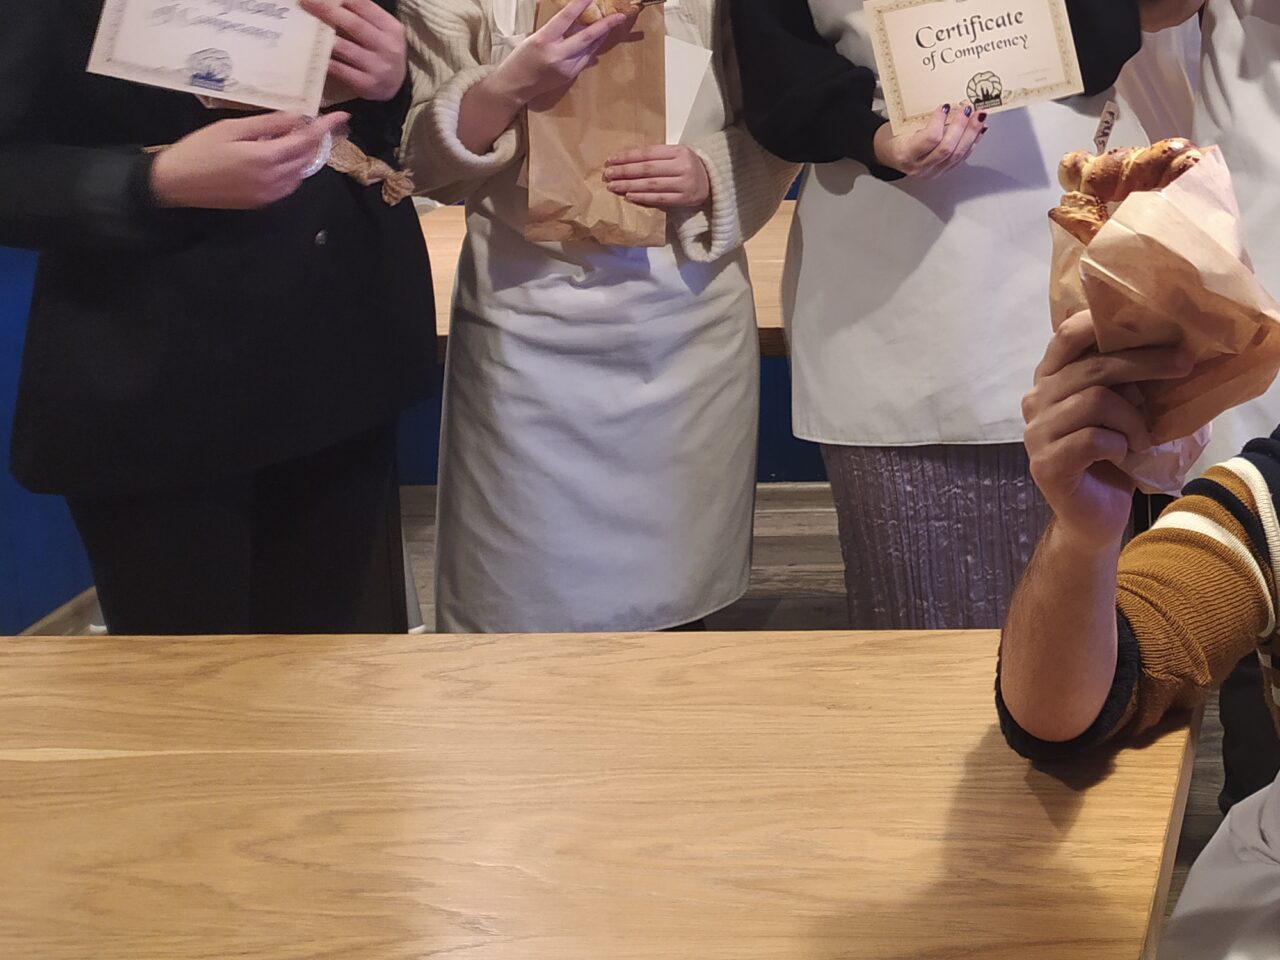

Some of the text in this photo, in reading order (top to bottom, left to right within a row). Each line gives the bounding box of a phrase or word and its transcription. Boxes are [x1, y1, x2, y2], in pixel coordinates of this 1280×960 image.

[915, 10, 1024, 49] Certificate
[922, 33, 1029, 71] of Competency
